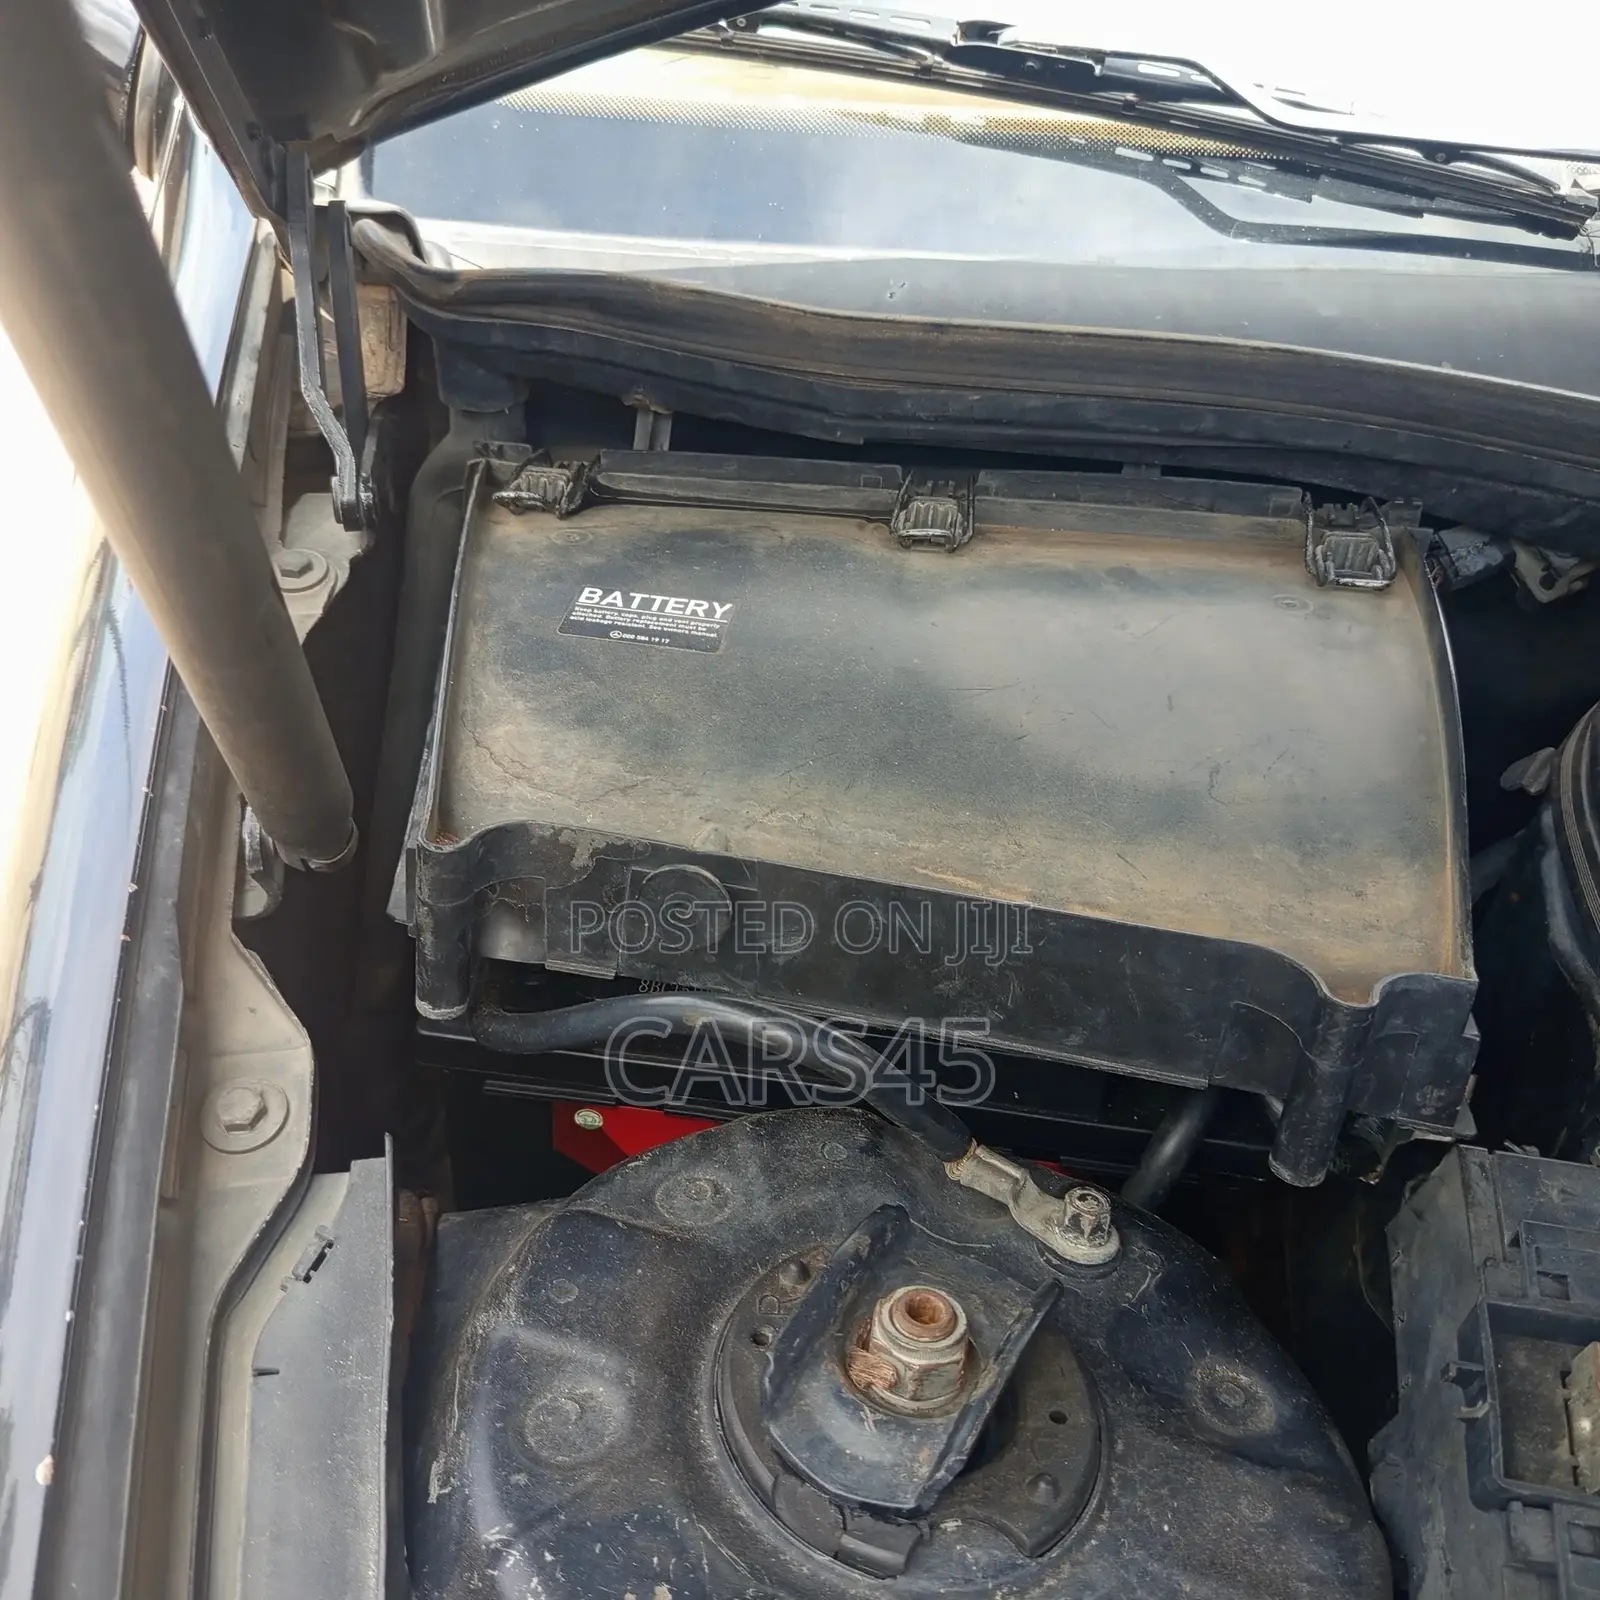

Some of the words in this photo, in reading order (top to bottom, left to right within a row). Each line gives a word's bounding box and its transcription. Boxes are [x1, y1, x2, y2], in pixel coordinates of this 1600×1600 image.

[578, 587, 733, 619] BATTERY
[632, 619, 677, 627] replacement
[690, 621, 720, 629] properly
